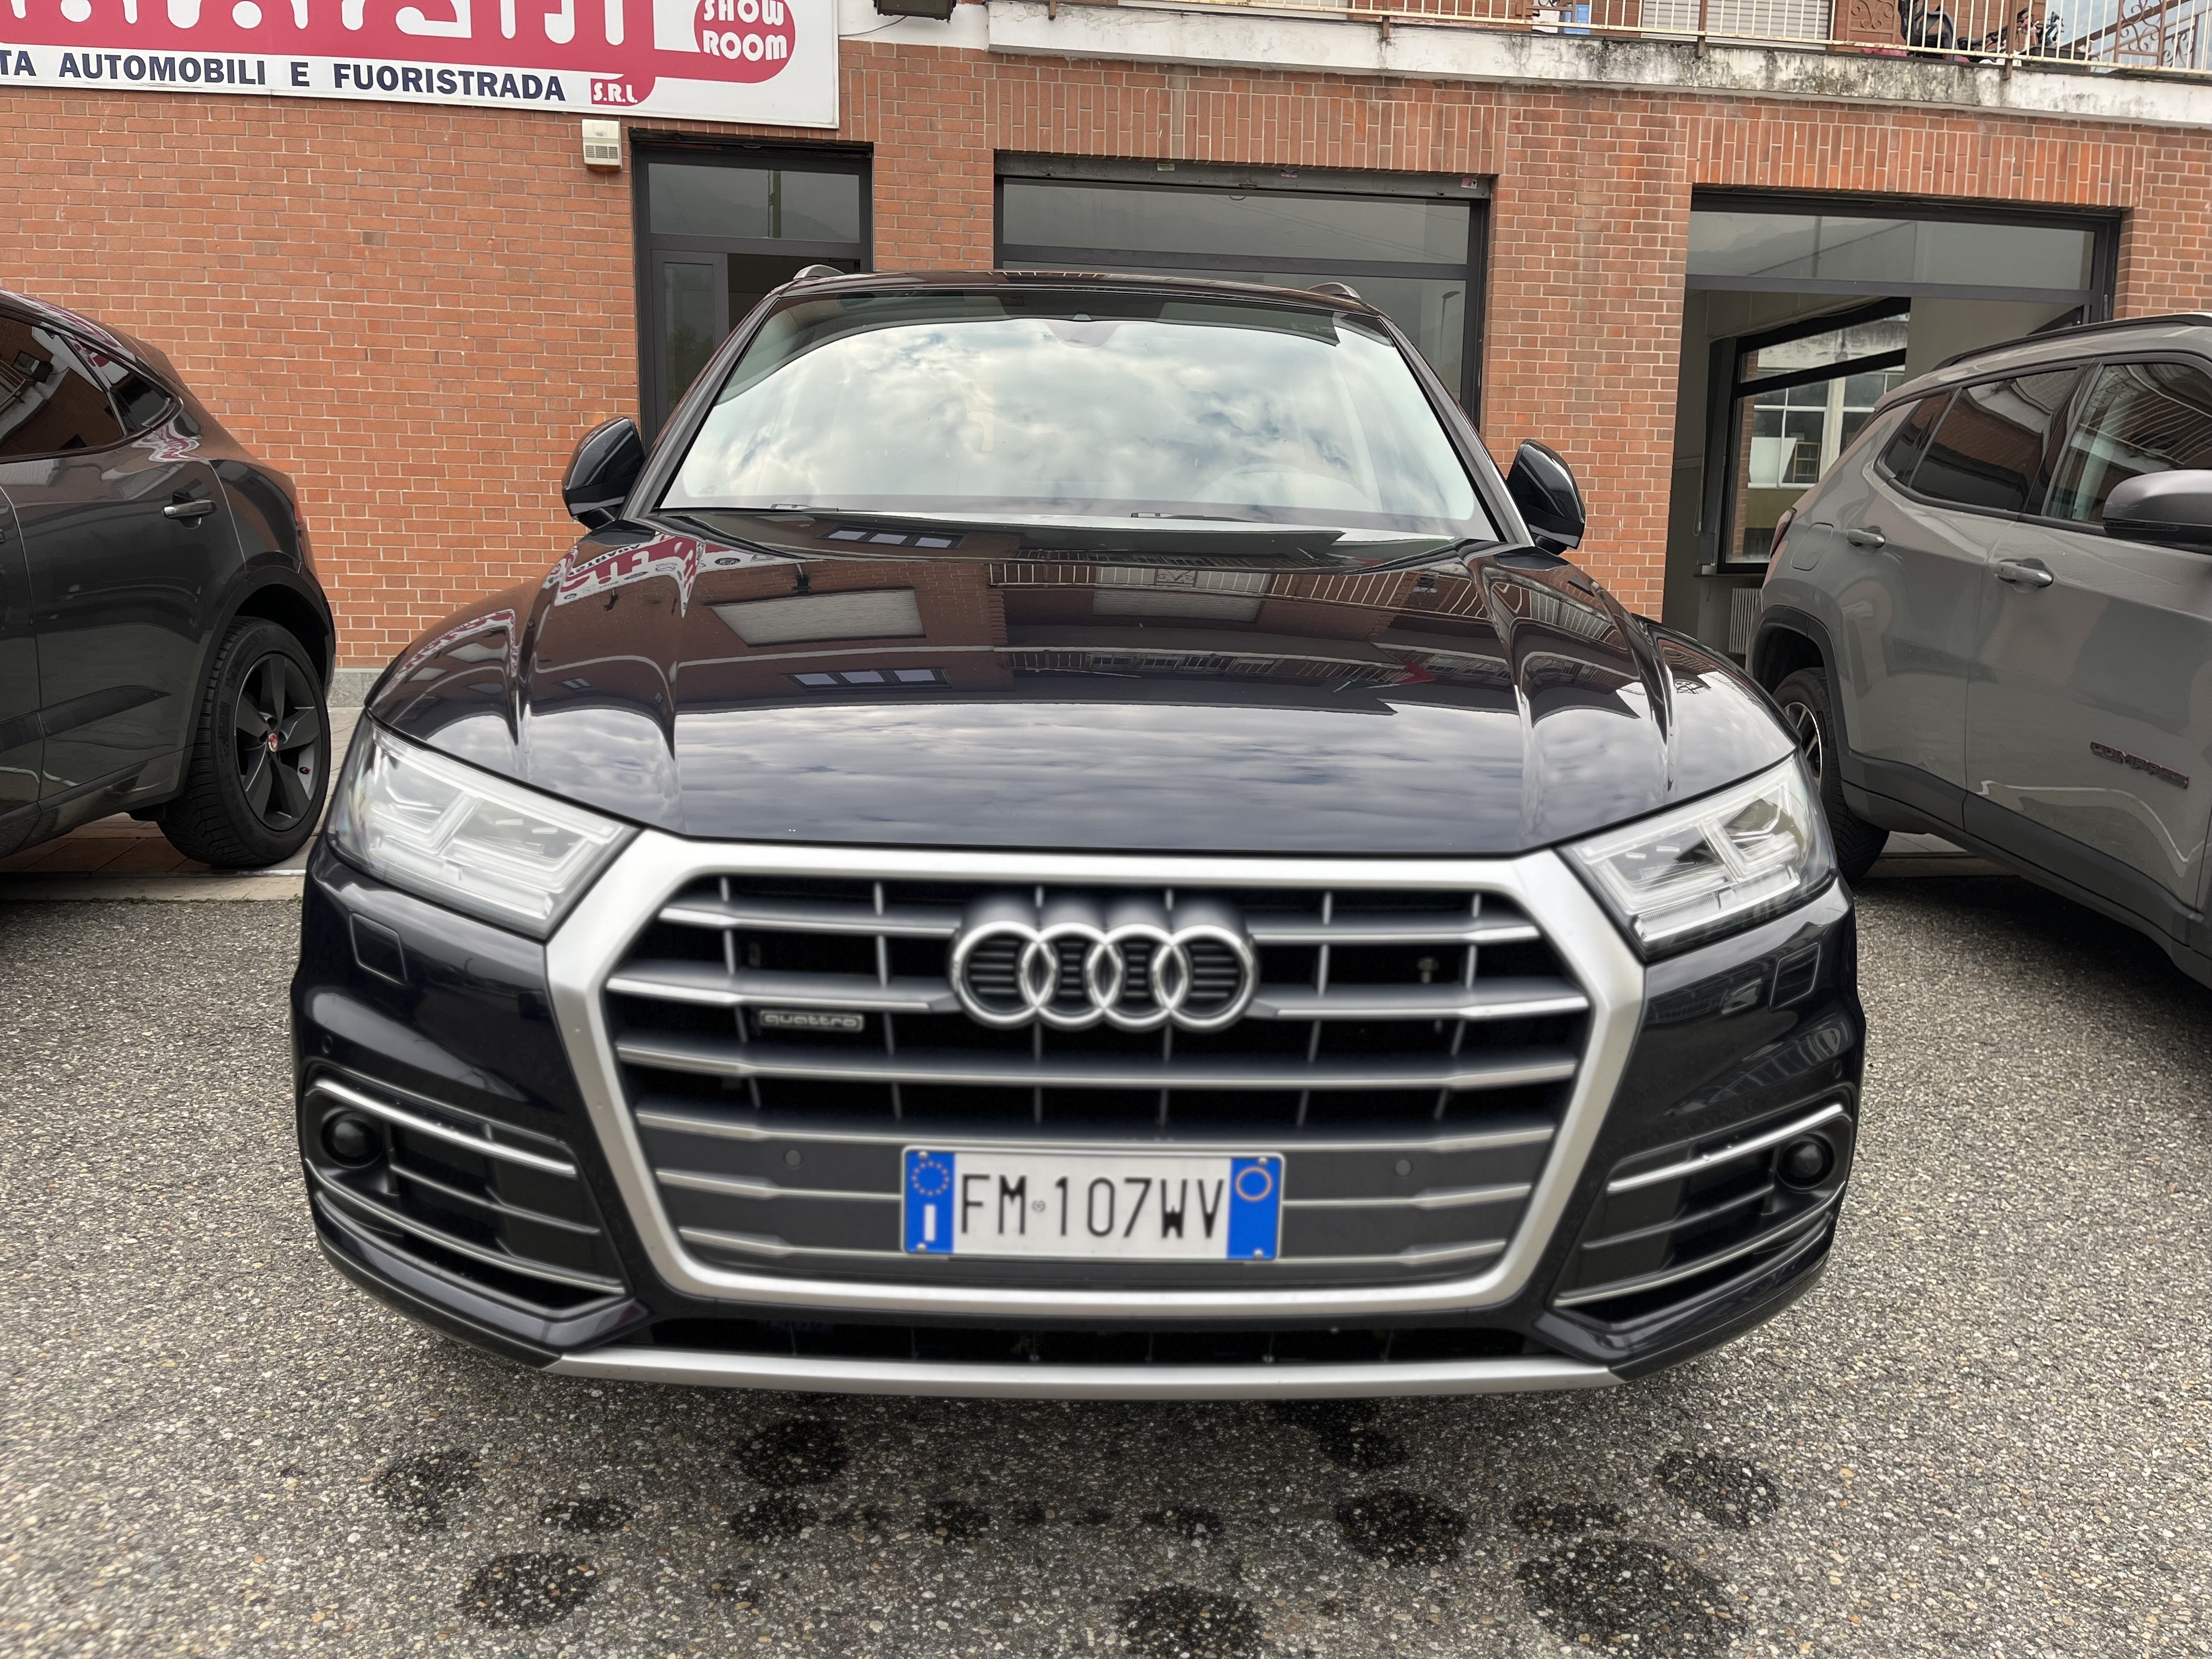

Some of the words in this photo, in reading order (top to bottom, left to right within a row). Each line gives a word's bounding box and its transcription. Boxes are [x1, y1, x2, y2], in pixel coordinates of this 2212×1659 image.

[703, 0, 784, 26] SHOW
[702, 30, 787, 61] ROOM
[59, 53, 266, 85] AUTOMOBILI
[290, 61, 310, 87] E
[334, 63, 566, 101] FUORISTRADA
[593, 82, 638, 103] S.R.L.
[764, 1015, 857, 1028] quattro
[961, 1174, 1027, 1235] FM
[1054, 1176, 1224, 1239] 107WV
